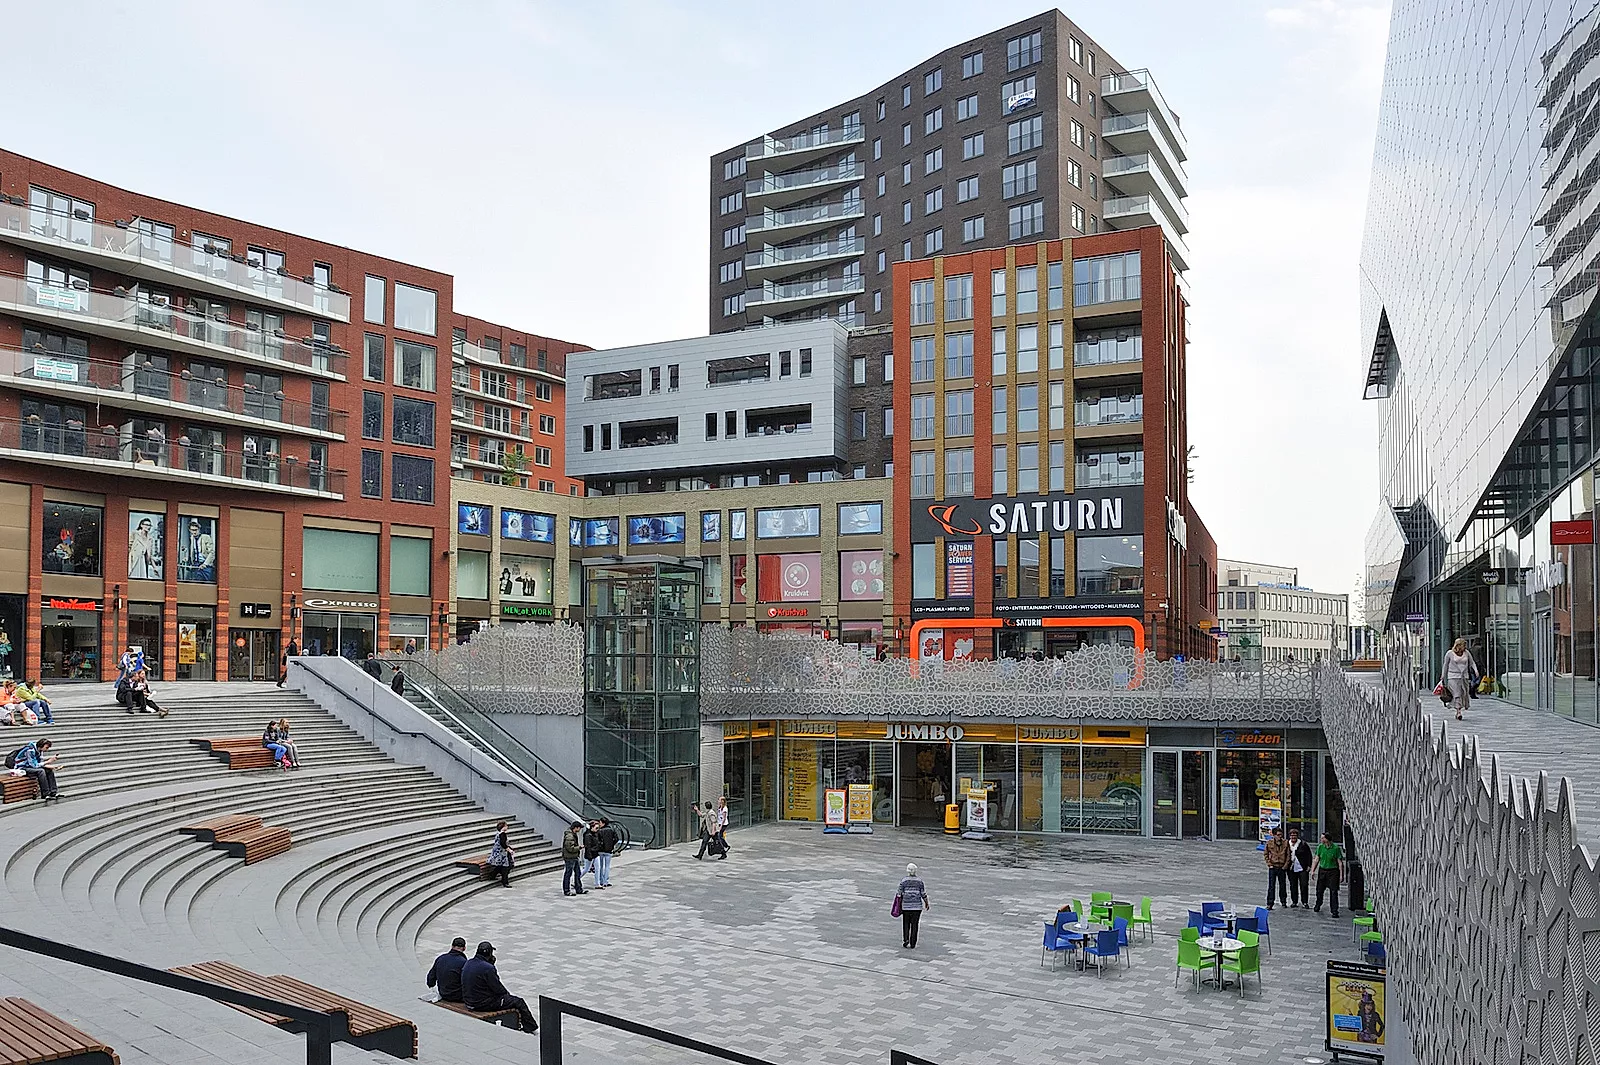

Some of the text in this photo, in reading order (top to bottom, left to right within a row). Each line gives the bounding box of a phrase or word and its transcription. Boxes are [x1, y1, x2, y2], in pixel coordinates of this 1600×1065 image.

[989, 497, 1123, 534] SATURN
[777, 608, 808, 617] Kruidvat
[1015, 618, 1042, 627] SATURN
[785, 720, 835, 734] JUMBO
[883, 724, 964, 741] JUMBO
[1022, 727, 1079, 740] JUMBO
